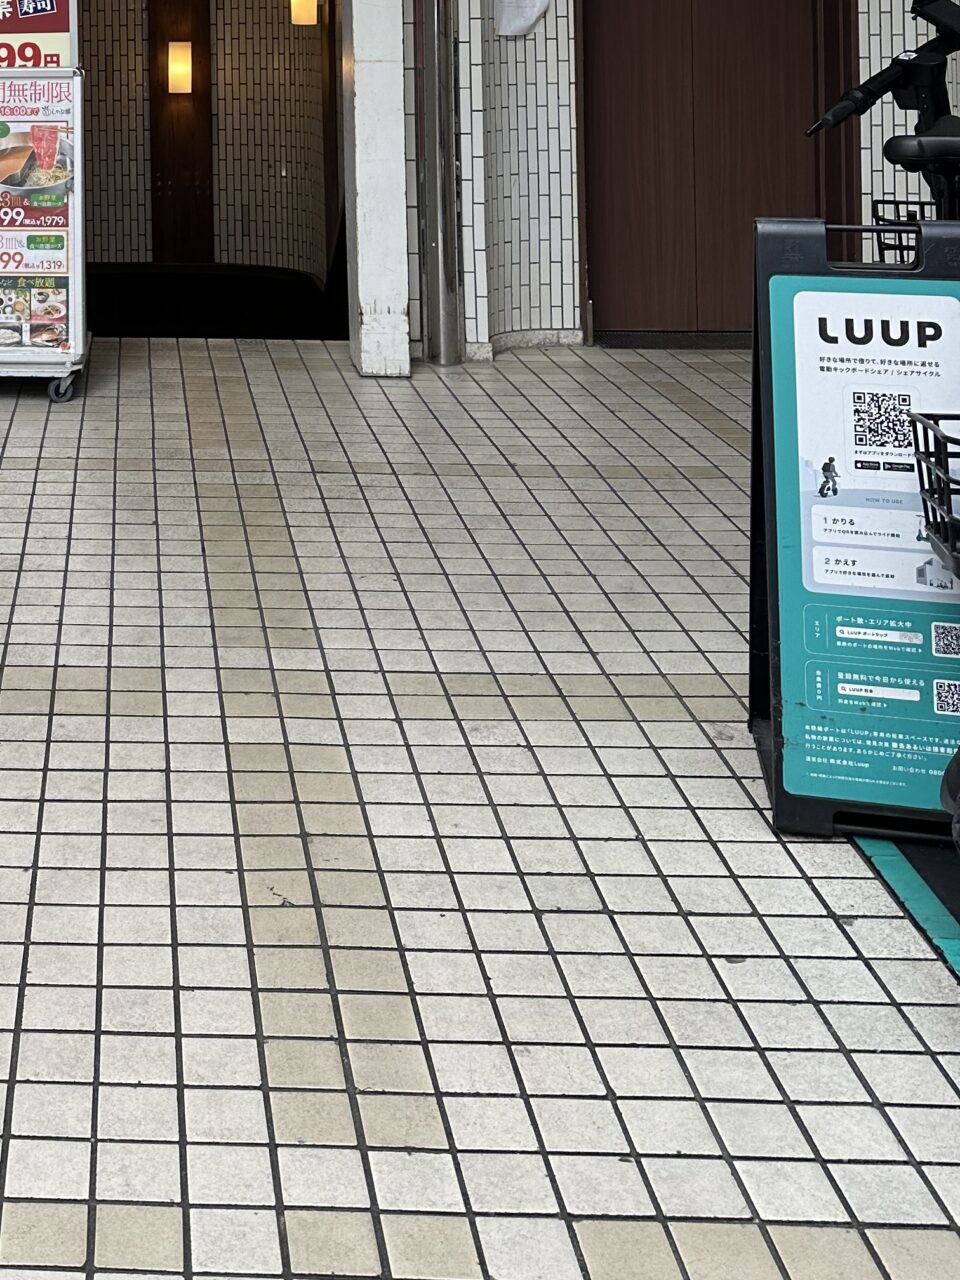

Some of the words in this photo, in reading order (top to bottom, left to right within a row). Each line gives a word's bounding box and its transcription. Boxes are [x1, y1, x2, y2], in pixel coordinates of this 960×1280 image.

[818, 317, 943, 348] LUUP
[832, 518, 856, 526] かりる
[834, 558, 858, 567] かえす
